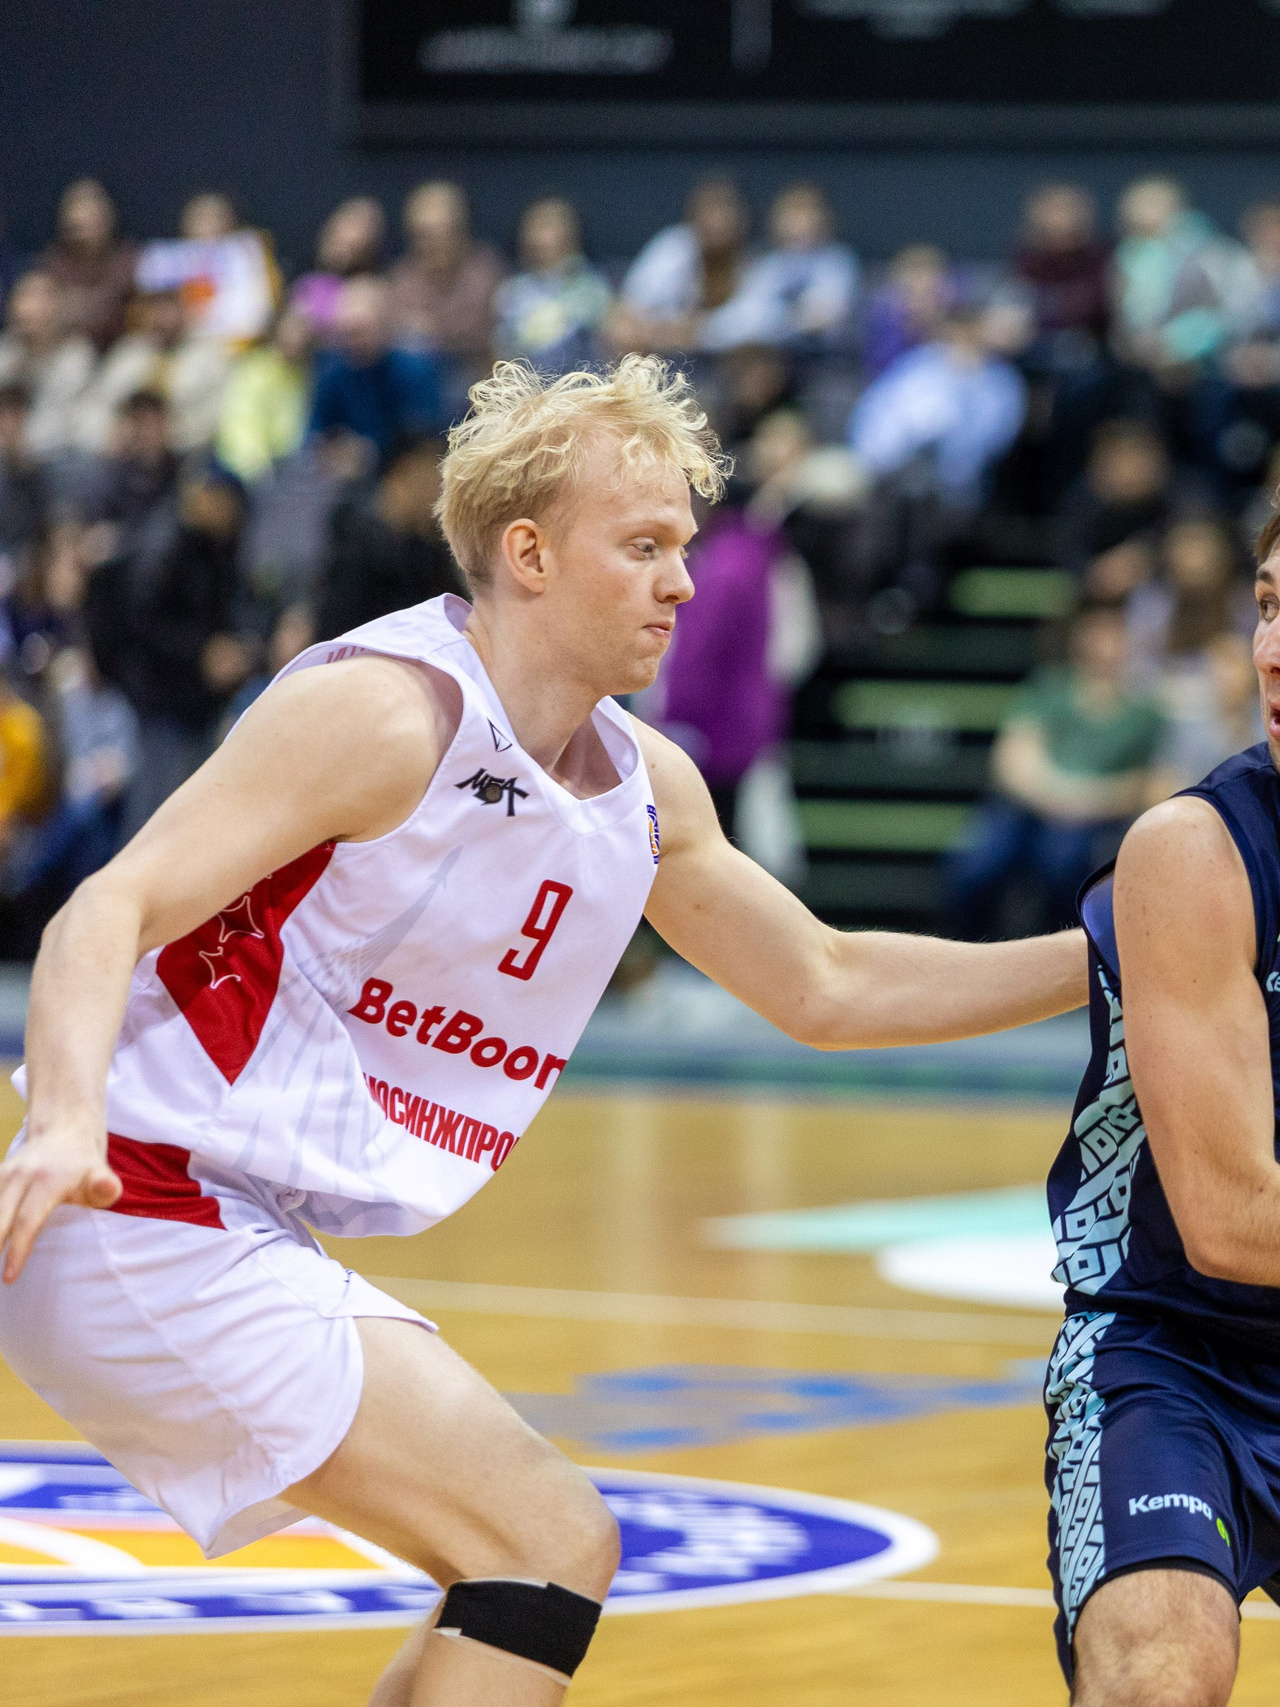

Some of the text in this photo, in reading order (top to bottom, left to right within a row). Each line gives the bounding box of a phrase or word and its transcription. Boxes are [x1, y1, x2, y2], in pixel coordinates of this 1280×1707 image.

[497, 879, 573, 981] 9
[362, 1072, 521, 1172] ОСИНЖПРО
[1128, 1493, 1212, 1521] Kempa
